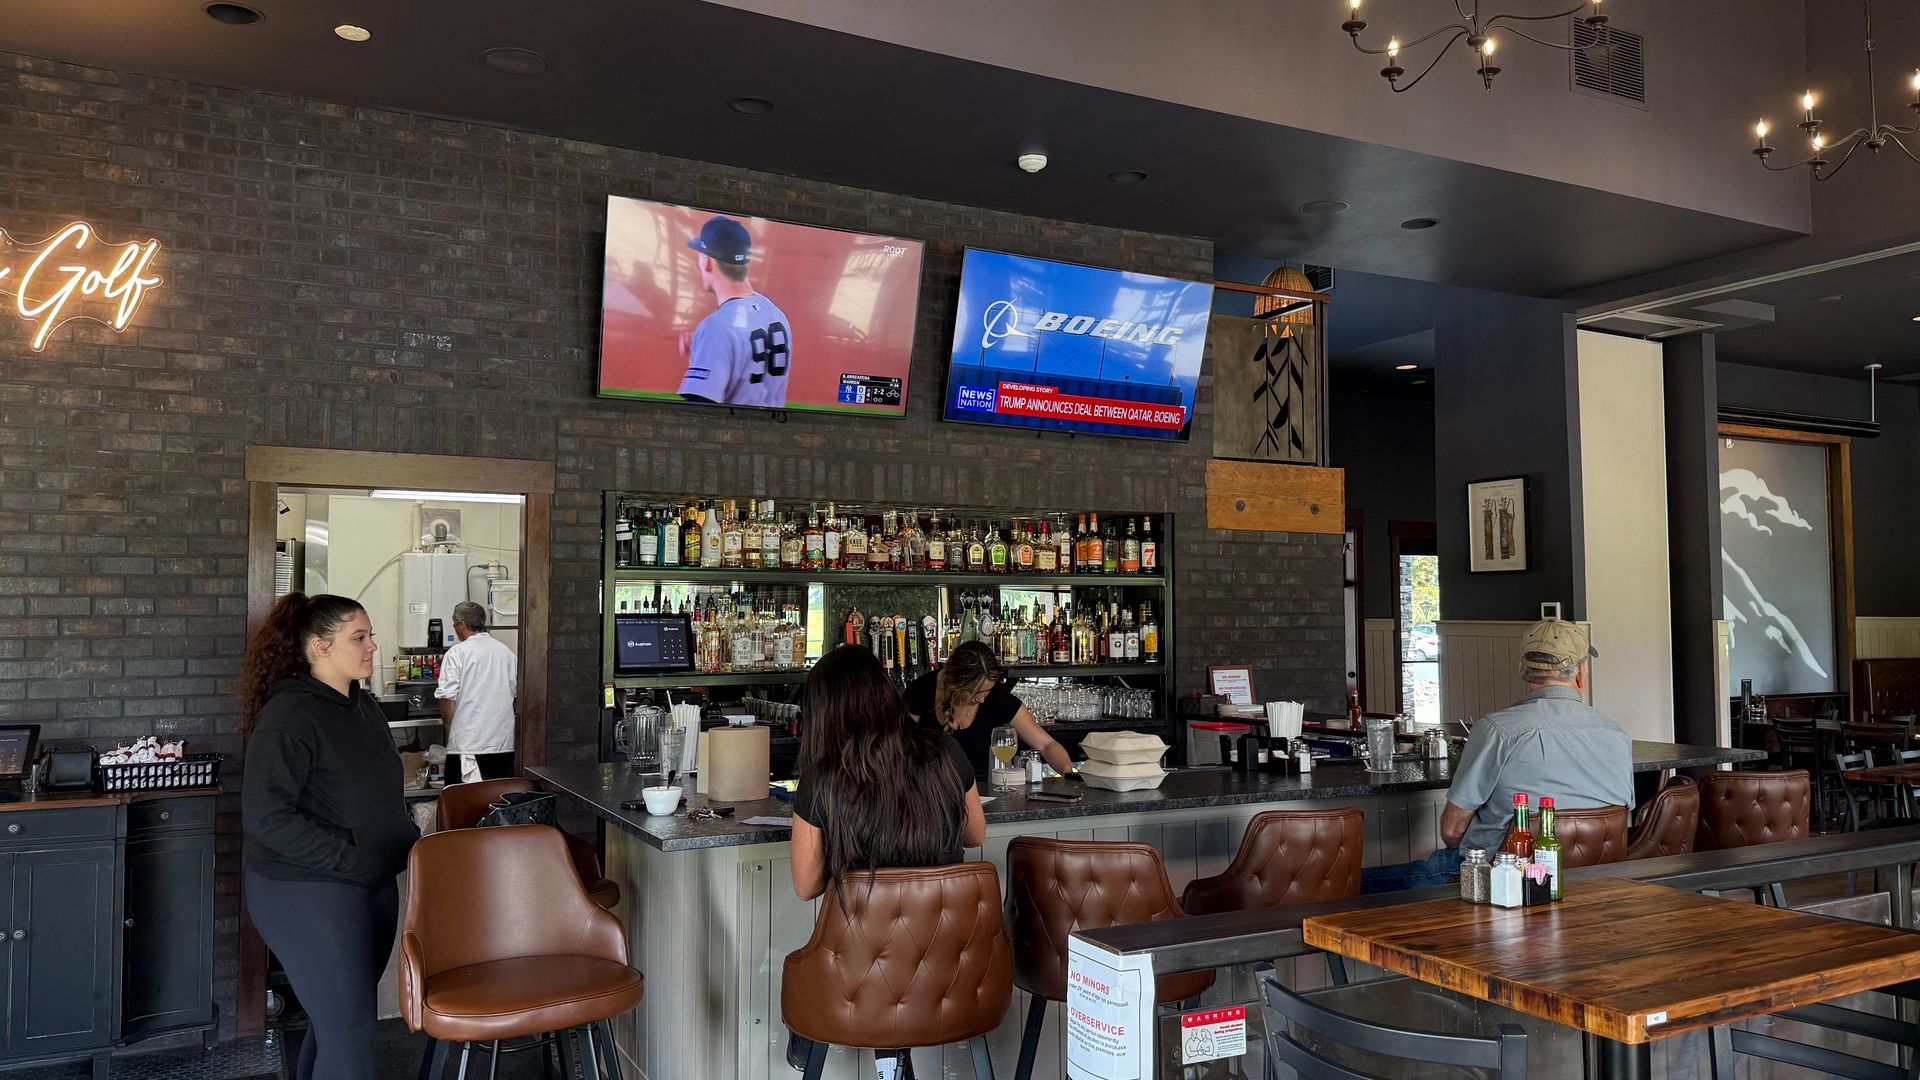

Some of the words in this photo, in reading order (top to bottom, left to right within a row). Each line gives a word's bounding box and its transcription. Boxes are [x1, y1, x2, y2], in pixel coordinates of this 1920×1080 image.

[883, 244, 907, 255] ROOT
[17, 223, 159, 349] Golf
[1033, 310, 1185, 346] BOEING
[749, 321, 789, 384] 98
[961, 389, 992, 400] NEWS
[1002, 383, 1035, 392] DEVELOPING
[960, 398, 992, 409] NATION
[1000, 395, 1026, 409] TRUMP
[1026, 398, 1074, 414] ANNOUNCES
[1074, 402, 1092, 416] DEAL
[1093, 404, 1128, 419] BETWEEN
[1127, 408, 1152, 423] QATAR,
[1153, 410, 1180, 424] BOEING
[1143, 548, 1154, 565] 7
[1070, 970, 1081, 982] NO
[1082, 975, 1110, 996] MINORS
[1070, 1006, 1125, 1036] OVERSERVICE
[1187, 1009, 1241, 1023] WARNING
[1105, 1042, 1127, 1051] purchase
